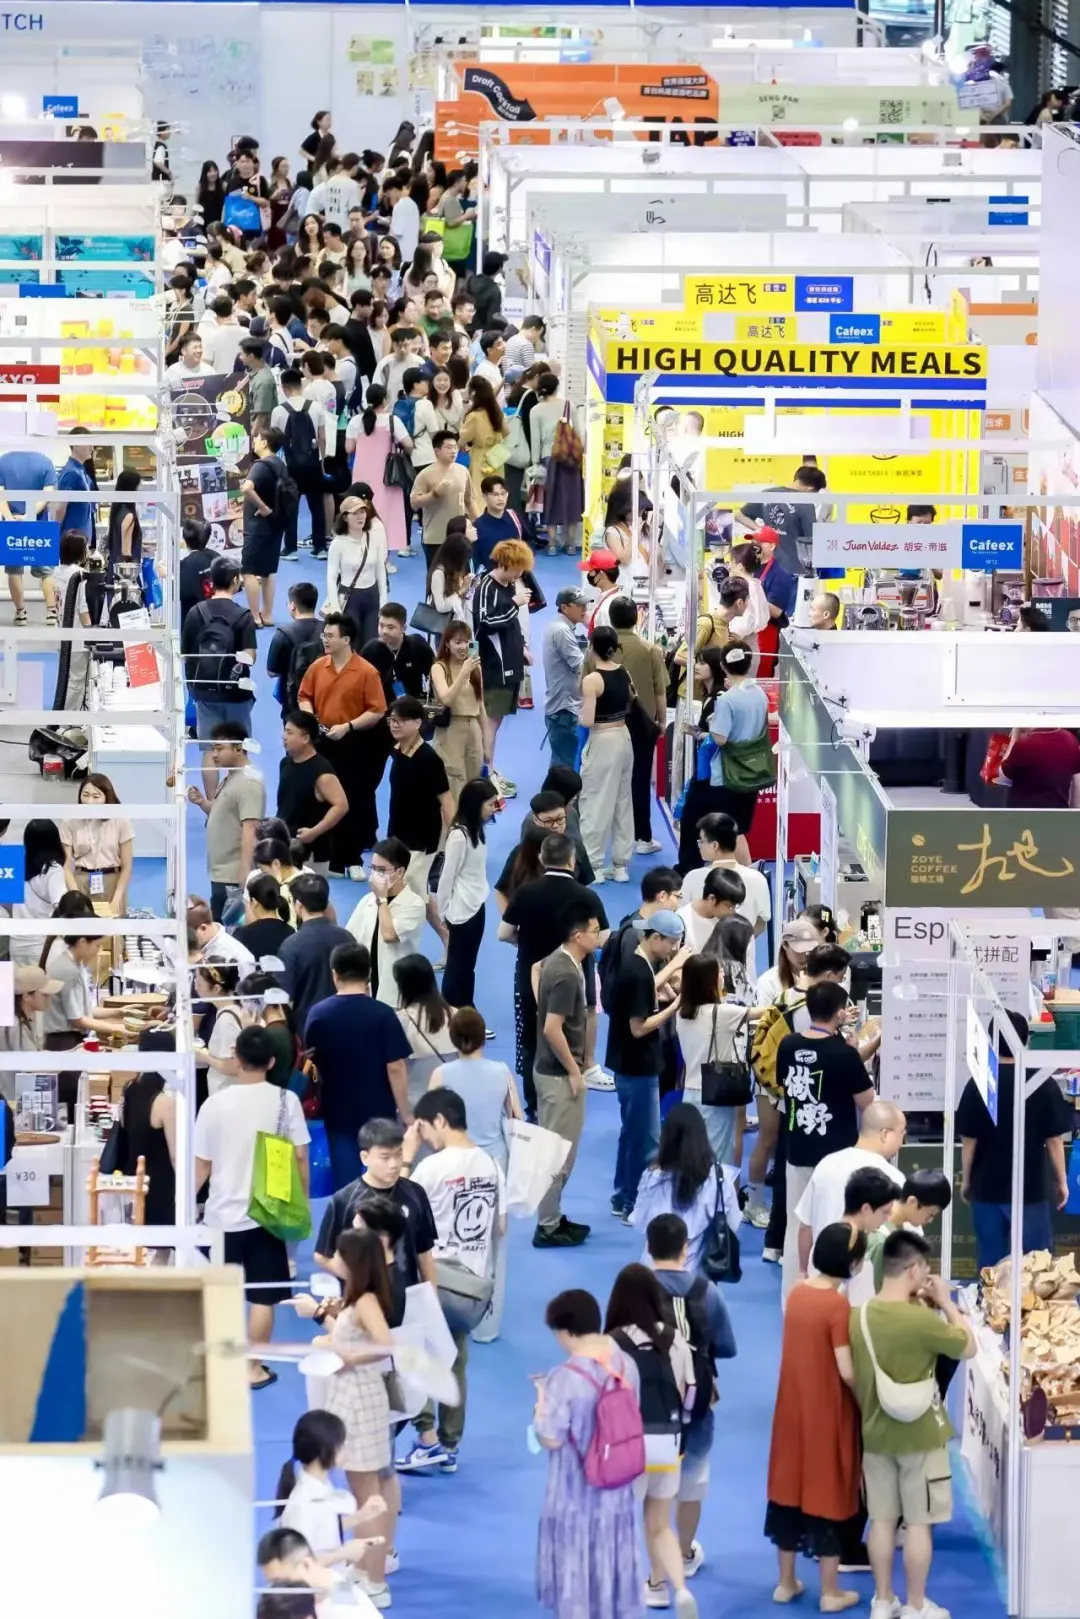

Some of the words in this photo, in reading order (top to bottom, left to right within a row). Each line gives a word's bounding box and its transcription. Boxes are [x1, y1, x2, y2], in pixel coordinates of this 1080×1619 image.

[471, 74, 495, 90] Draft
[492, 84, 522, 115] Cocktail
[695, 282, 757, 306] 高达飞
[747, 325, 786, 339] 高达飞
[835, 325, 875, 337] Cafeex
[617, 347, 702, 371] HIGH
[713, 348, 861, 378] QUALITY
[871, 351, 982, 375] MEALS
[6, 535, 52, 548] Cafeex
[842, 539, 868, 552] Juan
[867, 540, 898, 552] Valdez
[969, 539, 1014, 551] Cafeex
[911, 855, 944, 864] ZOYE
[911, 865, 958, 873] COFFEE
